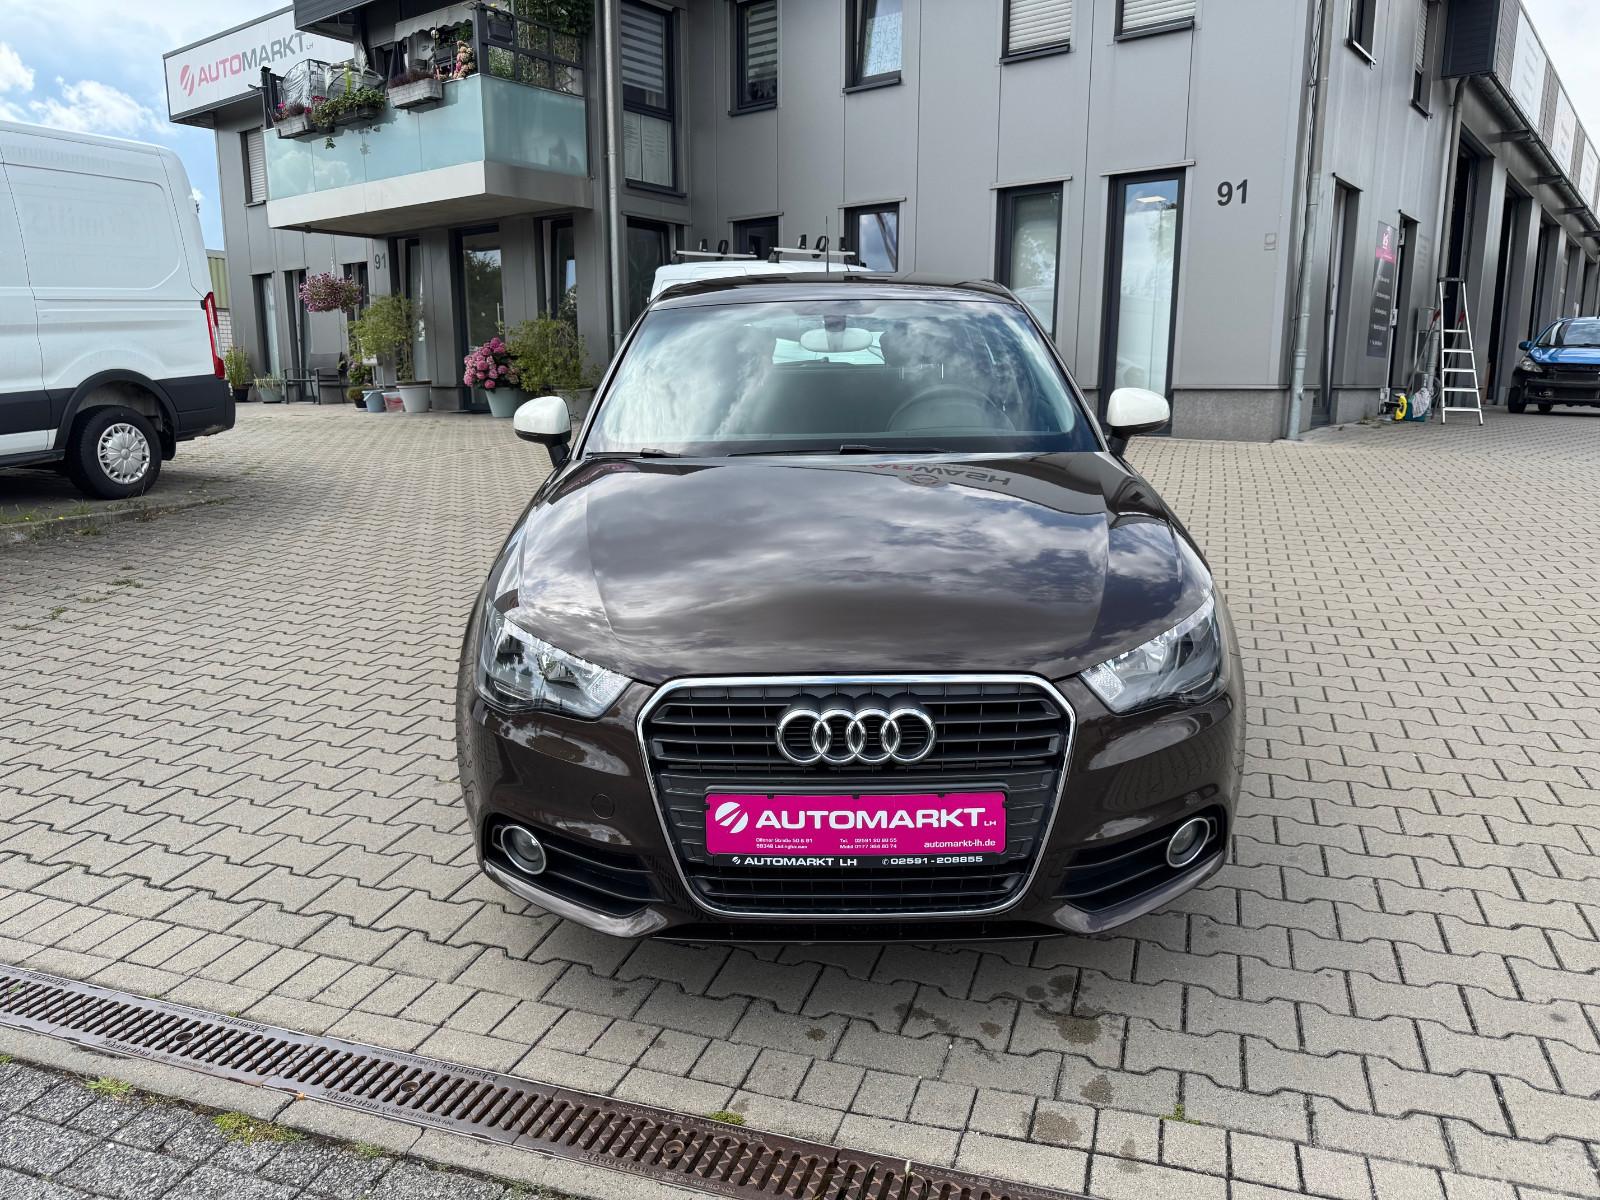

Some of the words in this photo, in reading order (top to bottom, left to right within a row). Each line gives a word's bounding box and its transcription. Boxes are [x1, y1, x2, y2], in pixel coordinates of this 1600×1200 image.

[198, 32, 306, 87] AUTOMARKT
[1217, 179, 1248, 207] 91
[374, 252, 387, 270] 91
[755, 807, 986, 830] AUTOMARKT
[923, 838, 997, 849] automarkt-lh.de
[743, 856, 835, 867] AUTOMARKT
[839, 858, 858, 867] LH
[890, 857, 929, 866] 02591
[936, 855, 984, 864] 208855
